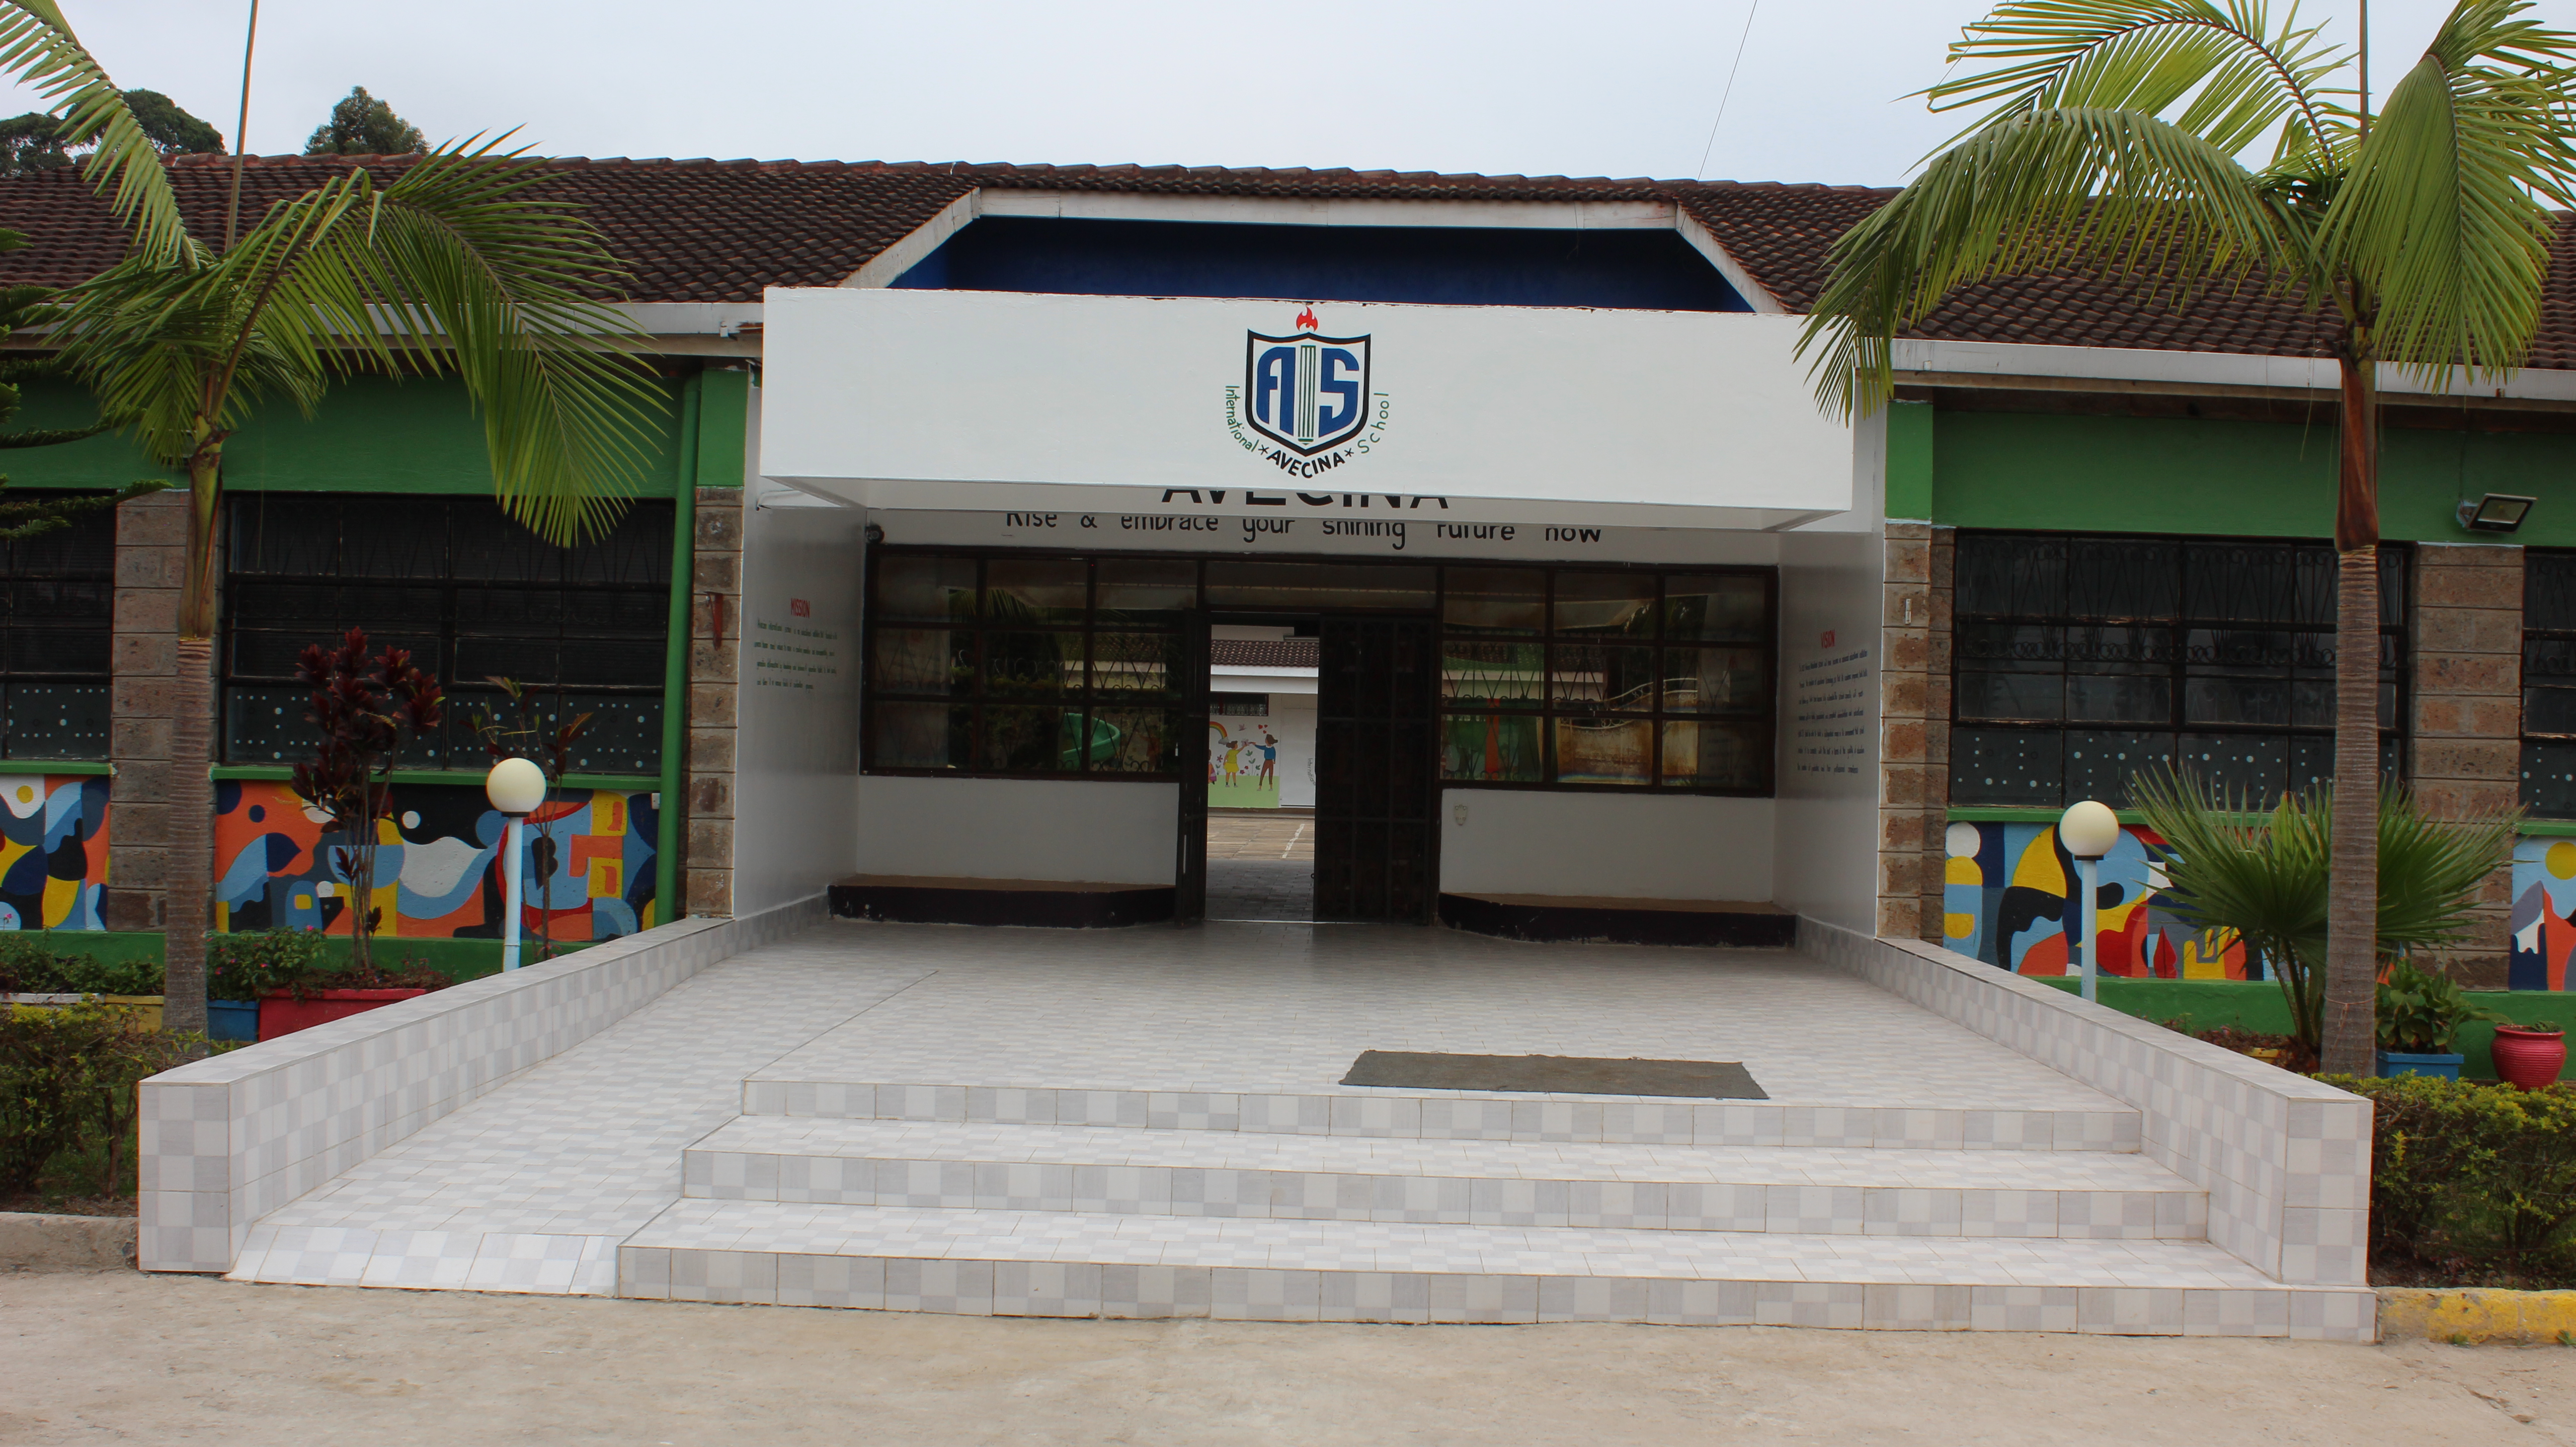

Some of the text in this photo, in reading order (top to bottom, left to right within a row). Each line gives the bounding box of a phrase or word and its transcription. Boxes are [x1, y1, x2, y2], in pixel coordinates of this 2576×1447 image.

[1225, 385, 1389, 479] International AVECINA School
[1243, 519, 1295, 543] your
[1545, 528, 1601, 543] now
[791, 598, 810, 618] MISSION
[1821, 629, 1835, 648] VISION
